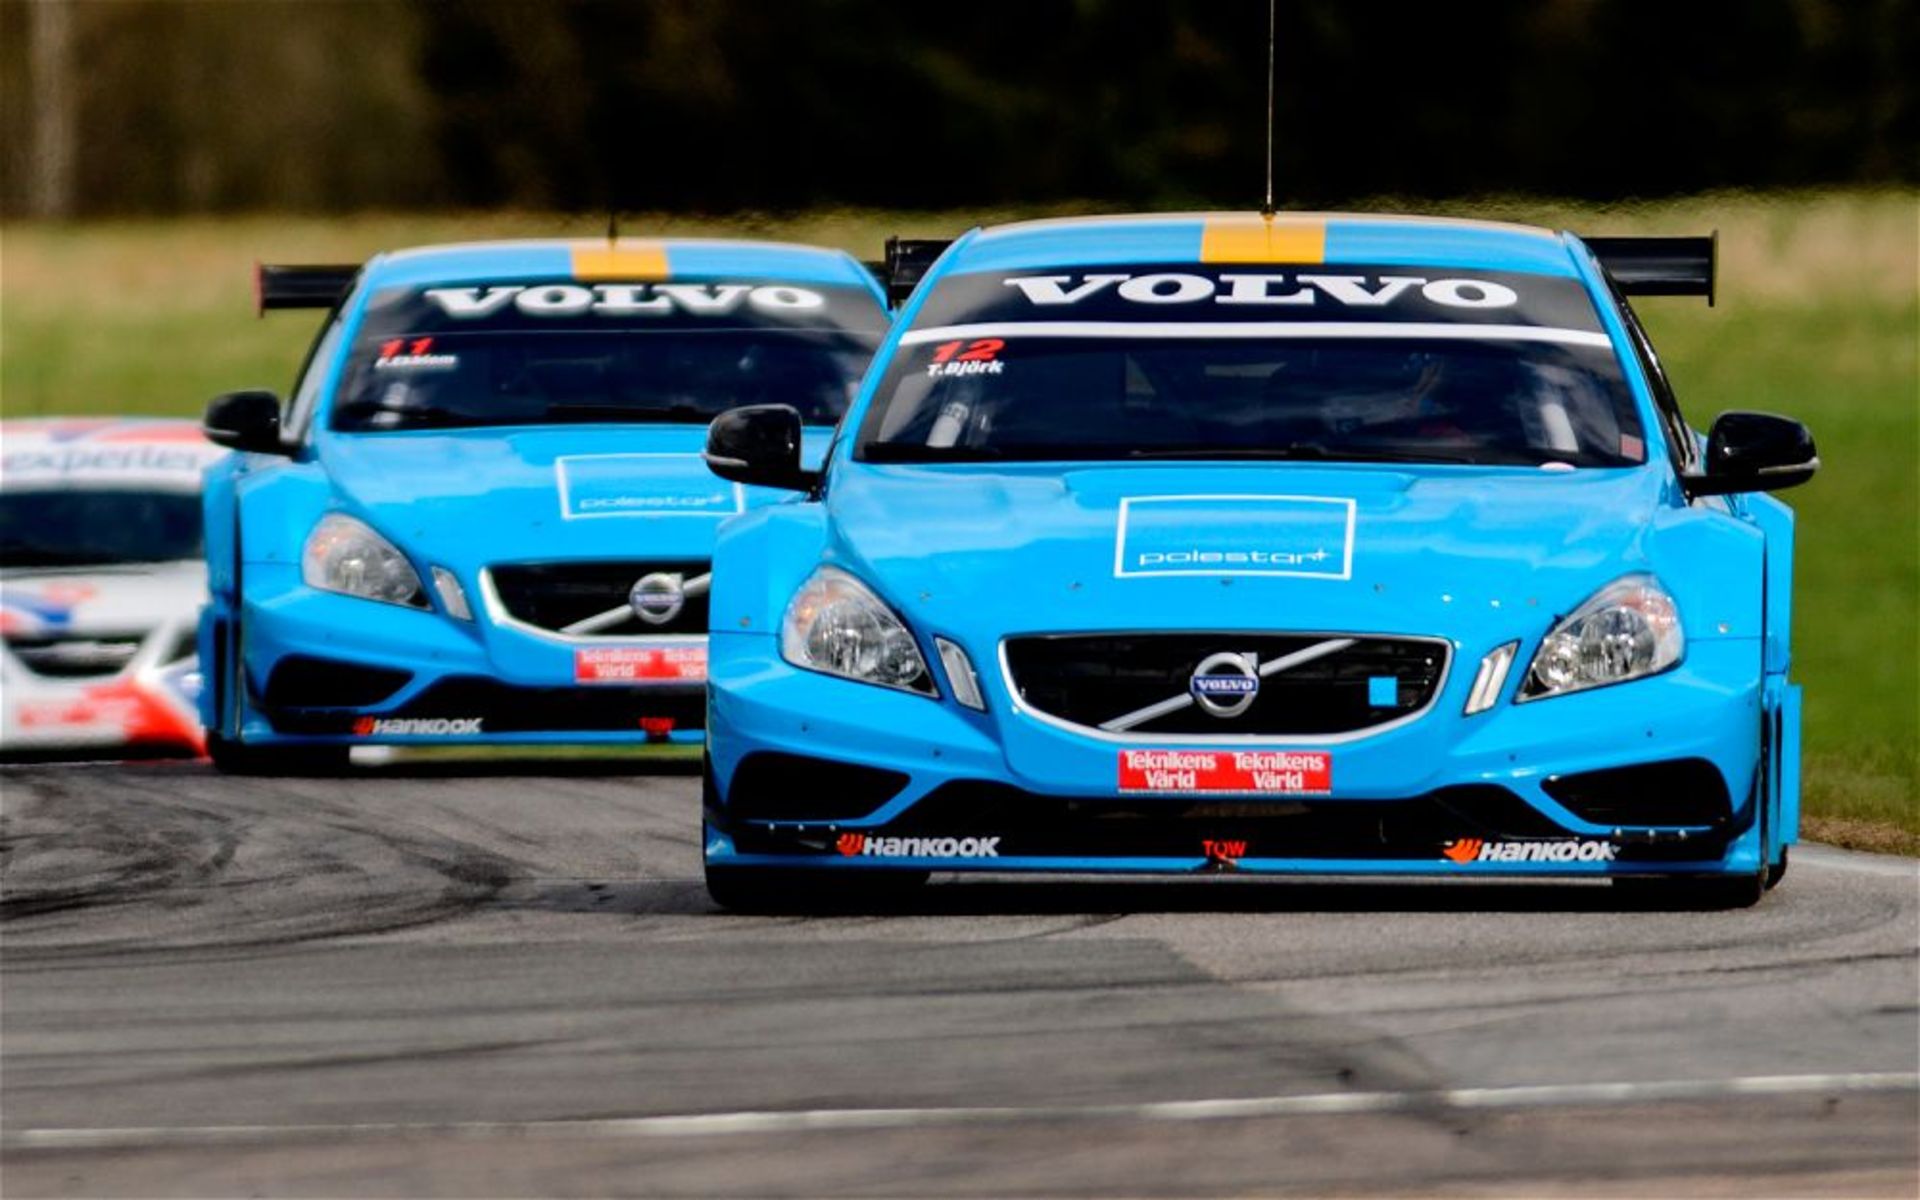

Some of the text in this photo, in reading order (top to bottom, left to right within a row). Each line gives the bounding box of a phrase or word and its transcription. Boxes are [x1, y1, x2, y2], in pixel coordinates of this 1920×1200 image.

[1004, 273, 1518, 309] VOLVO
[425, 284, 825, 318] VOLVO
[381, 338, 432, 357] 11
[933, 338, 1005, 363] 12
[928, 360, 1005, 376] T.Björk
[1139, 549, 1330, 566] polestar
[1197, 678, 1254, 692] VOLVO
[1125, 752, 1325, 771] Teknikens Teknikens
[1145, 769, 1304, 789] Värld Värld
[1203, 840, 1247, 859] TOW
